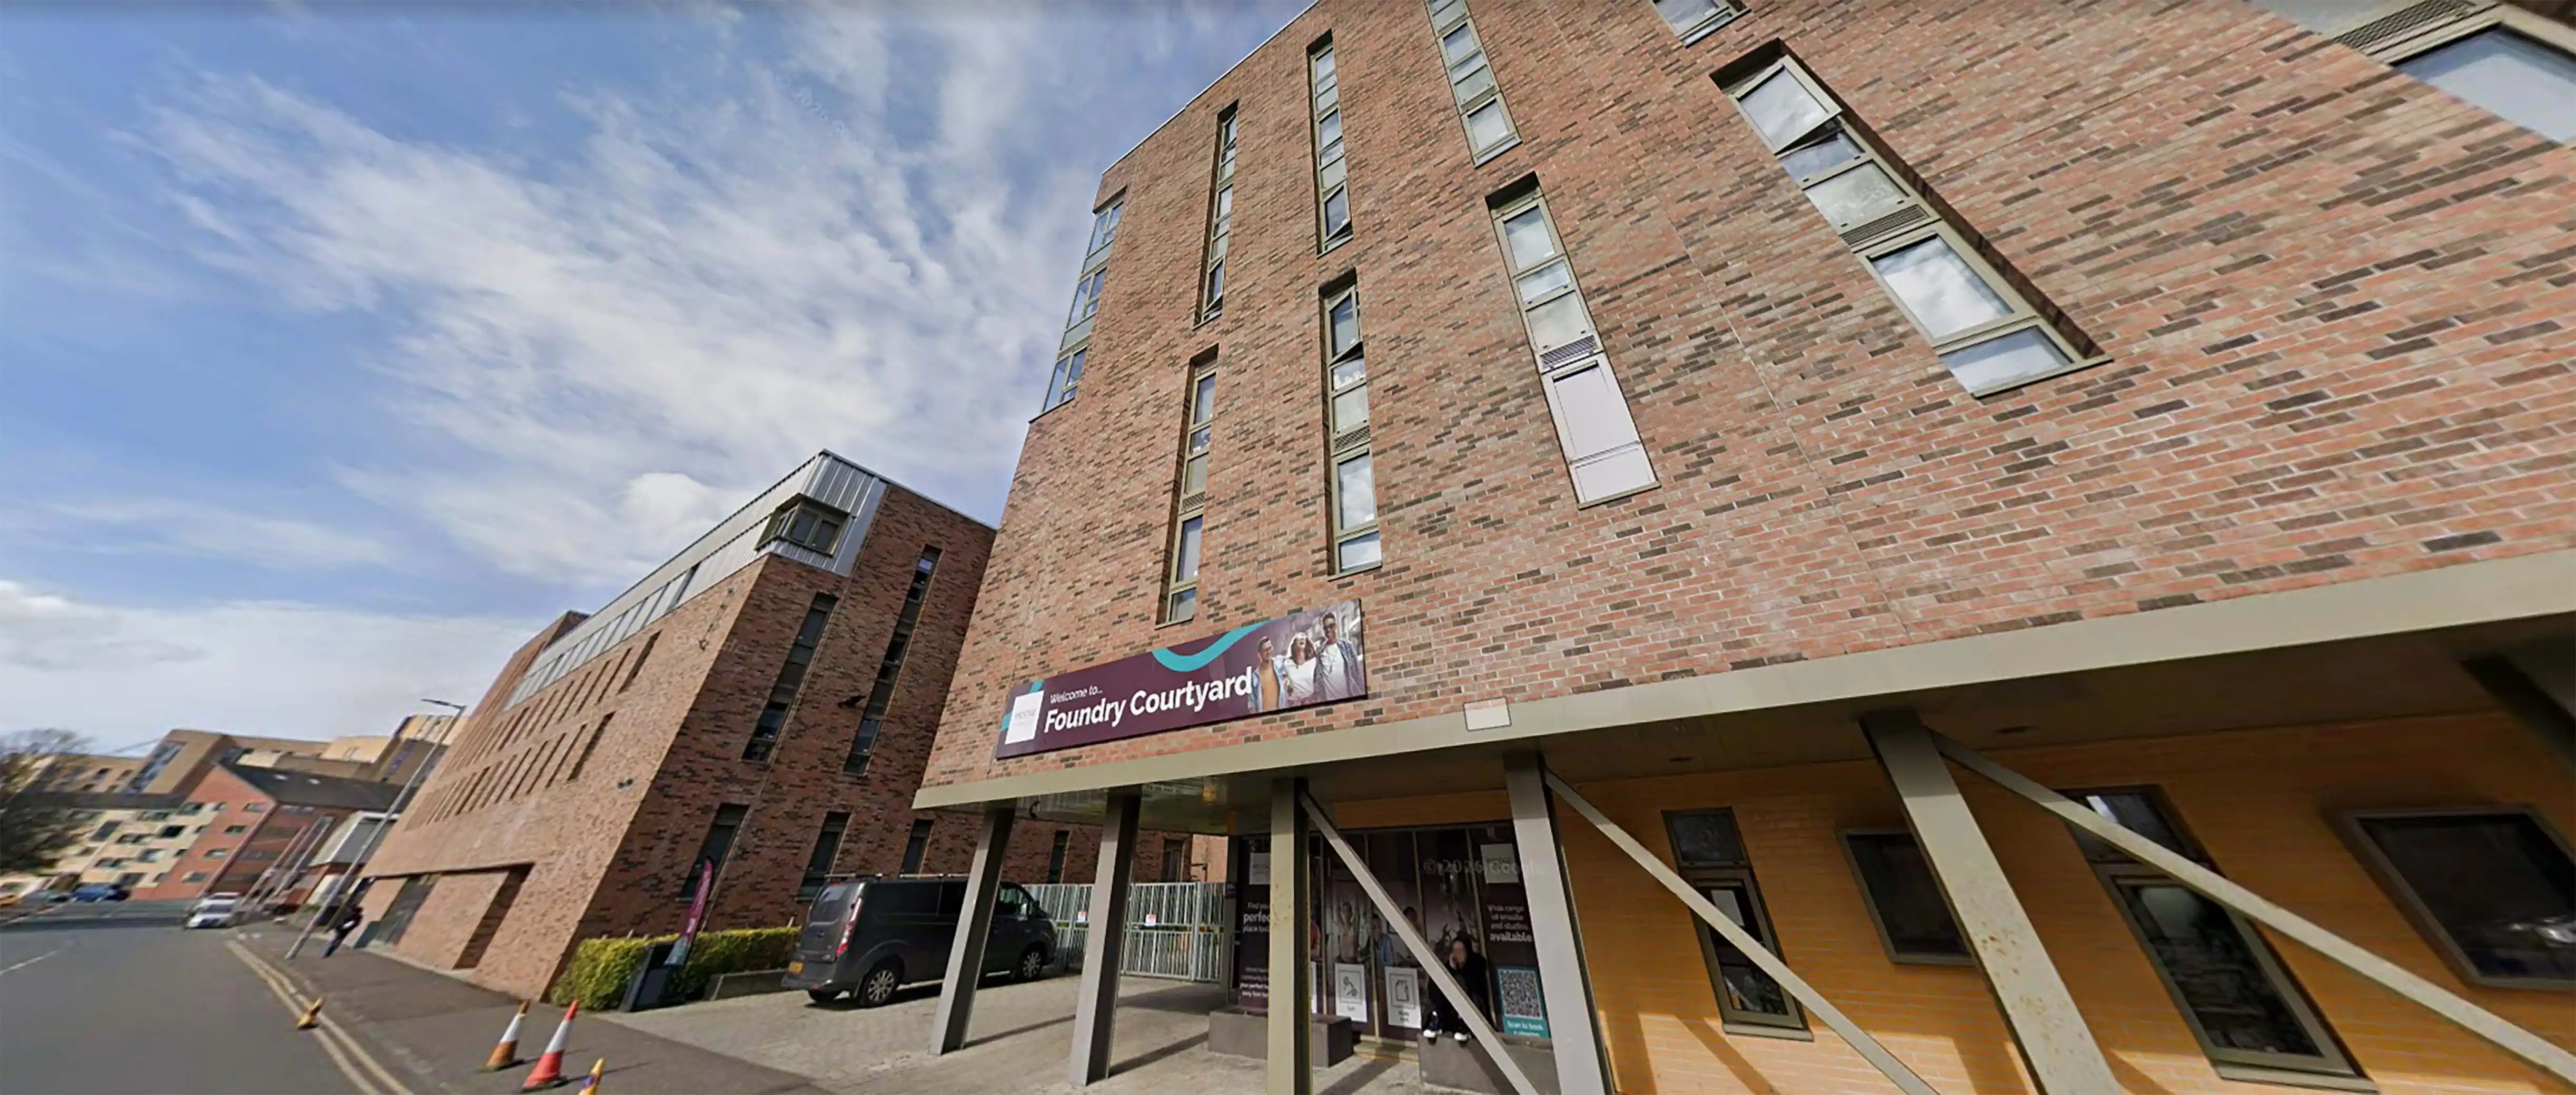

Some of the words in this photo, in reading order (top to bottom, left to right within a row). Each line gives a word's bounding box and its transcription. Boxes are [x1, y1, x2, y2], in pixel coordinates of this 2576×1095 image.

[1044, 697, 1127, 733] Foundry
[1130, 665, 1252, 716] Courtyard
[1050, 688, 1088, 704] Welcome
[1243, 911, 1270, 925] perfec
[1489, 931, 1533, 942] available
